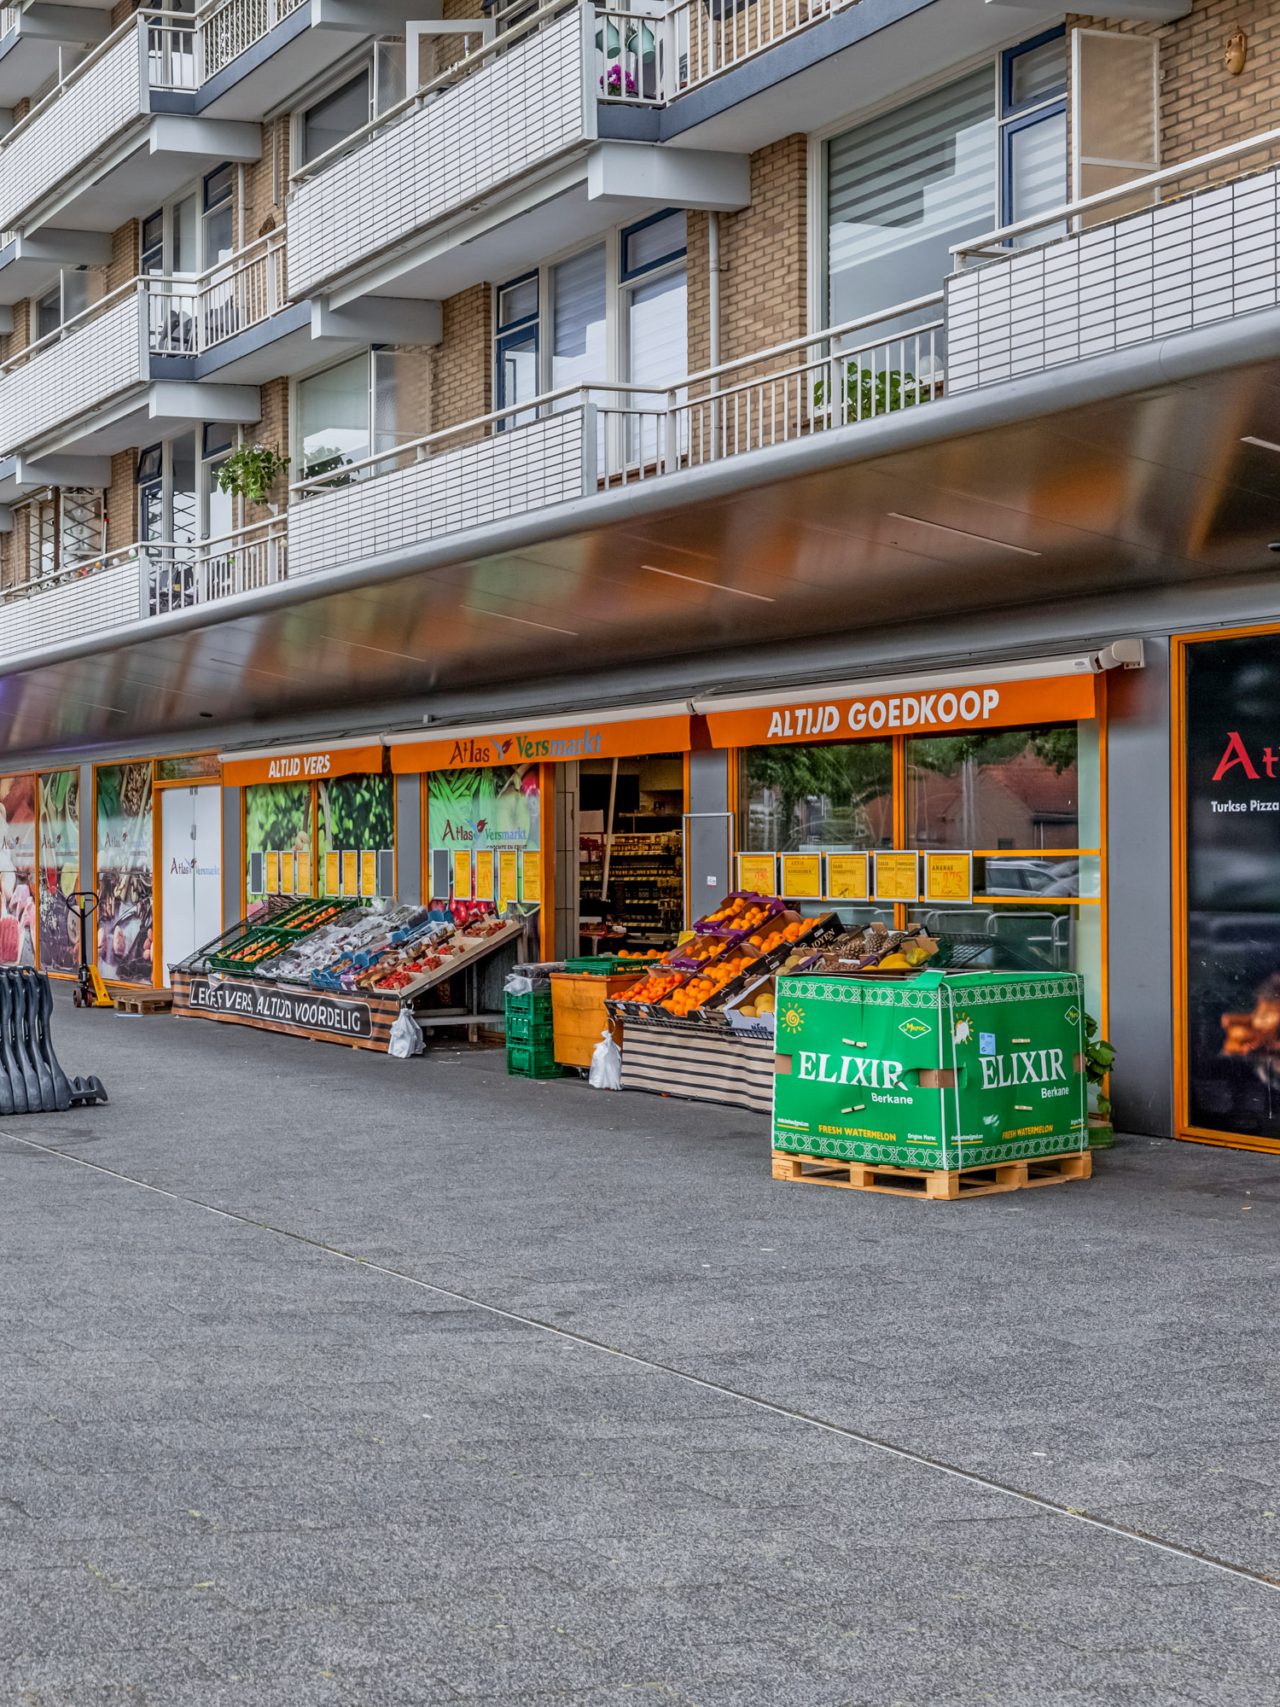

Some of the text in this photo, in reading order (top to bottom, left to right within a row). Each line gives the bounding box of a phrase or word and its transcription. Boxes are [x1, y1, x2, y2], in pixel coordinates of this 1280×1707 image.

[767, 689, 1000, 738] ALTIJD GOEDKOOP
[449, 729, 603, 765] Atlas Versmarkt
[268, 754, 331, 779] ALTIJD VERS
[1210, 800, 1280, 812] Turkse Pizza
[442, 819, 527, 841] Atlas Versmarkt
[170, 857, 189, 874] Atlas
[225, 990, 254, 1015] VERS,
[256, 996, 292, 1019] ALTIJD
[295, 1002, 361, 1032] VOORDELIG
[798, 1050, 909, 1091] ELIXIR
[978, 1048, 1067, 1090] ELIXIR
[871, 1092, 913, 1105] Berkane
[1041, 1086, 1069, 1099] Berkane
[818, 1124, 897, 1142] FRESH WATERMELON
[1002, 1124, 1054, 1140] FRESH WATERMELON
